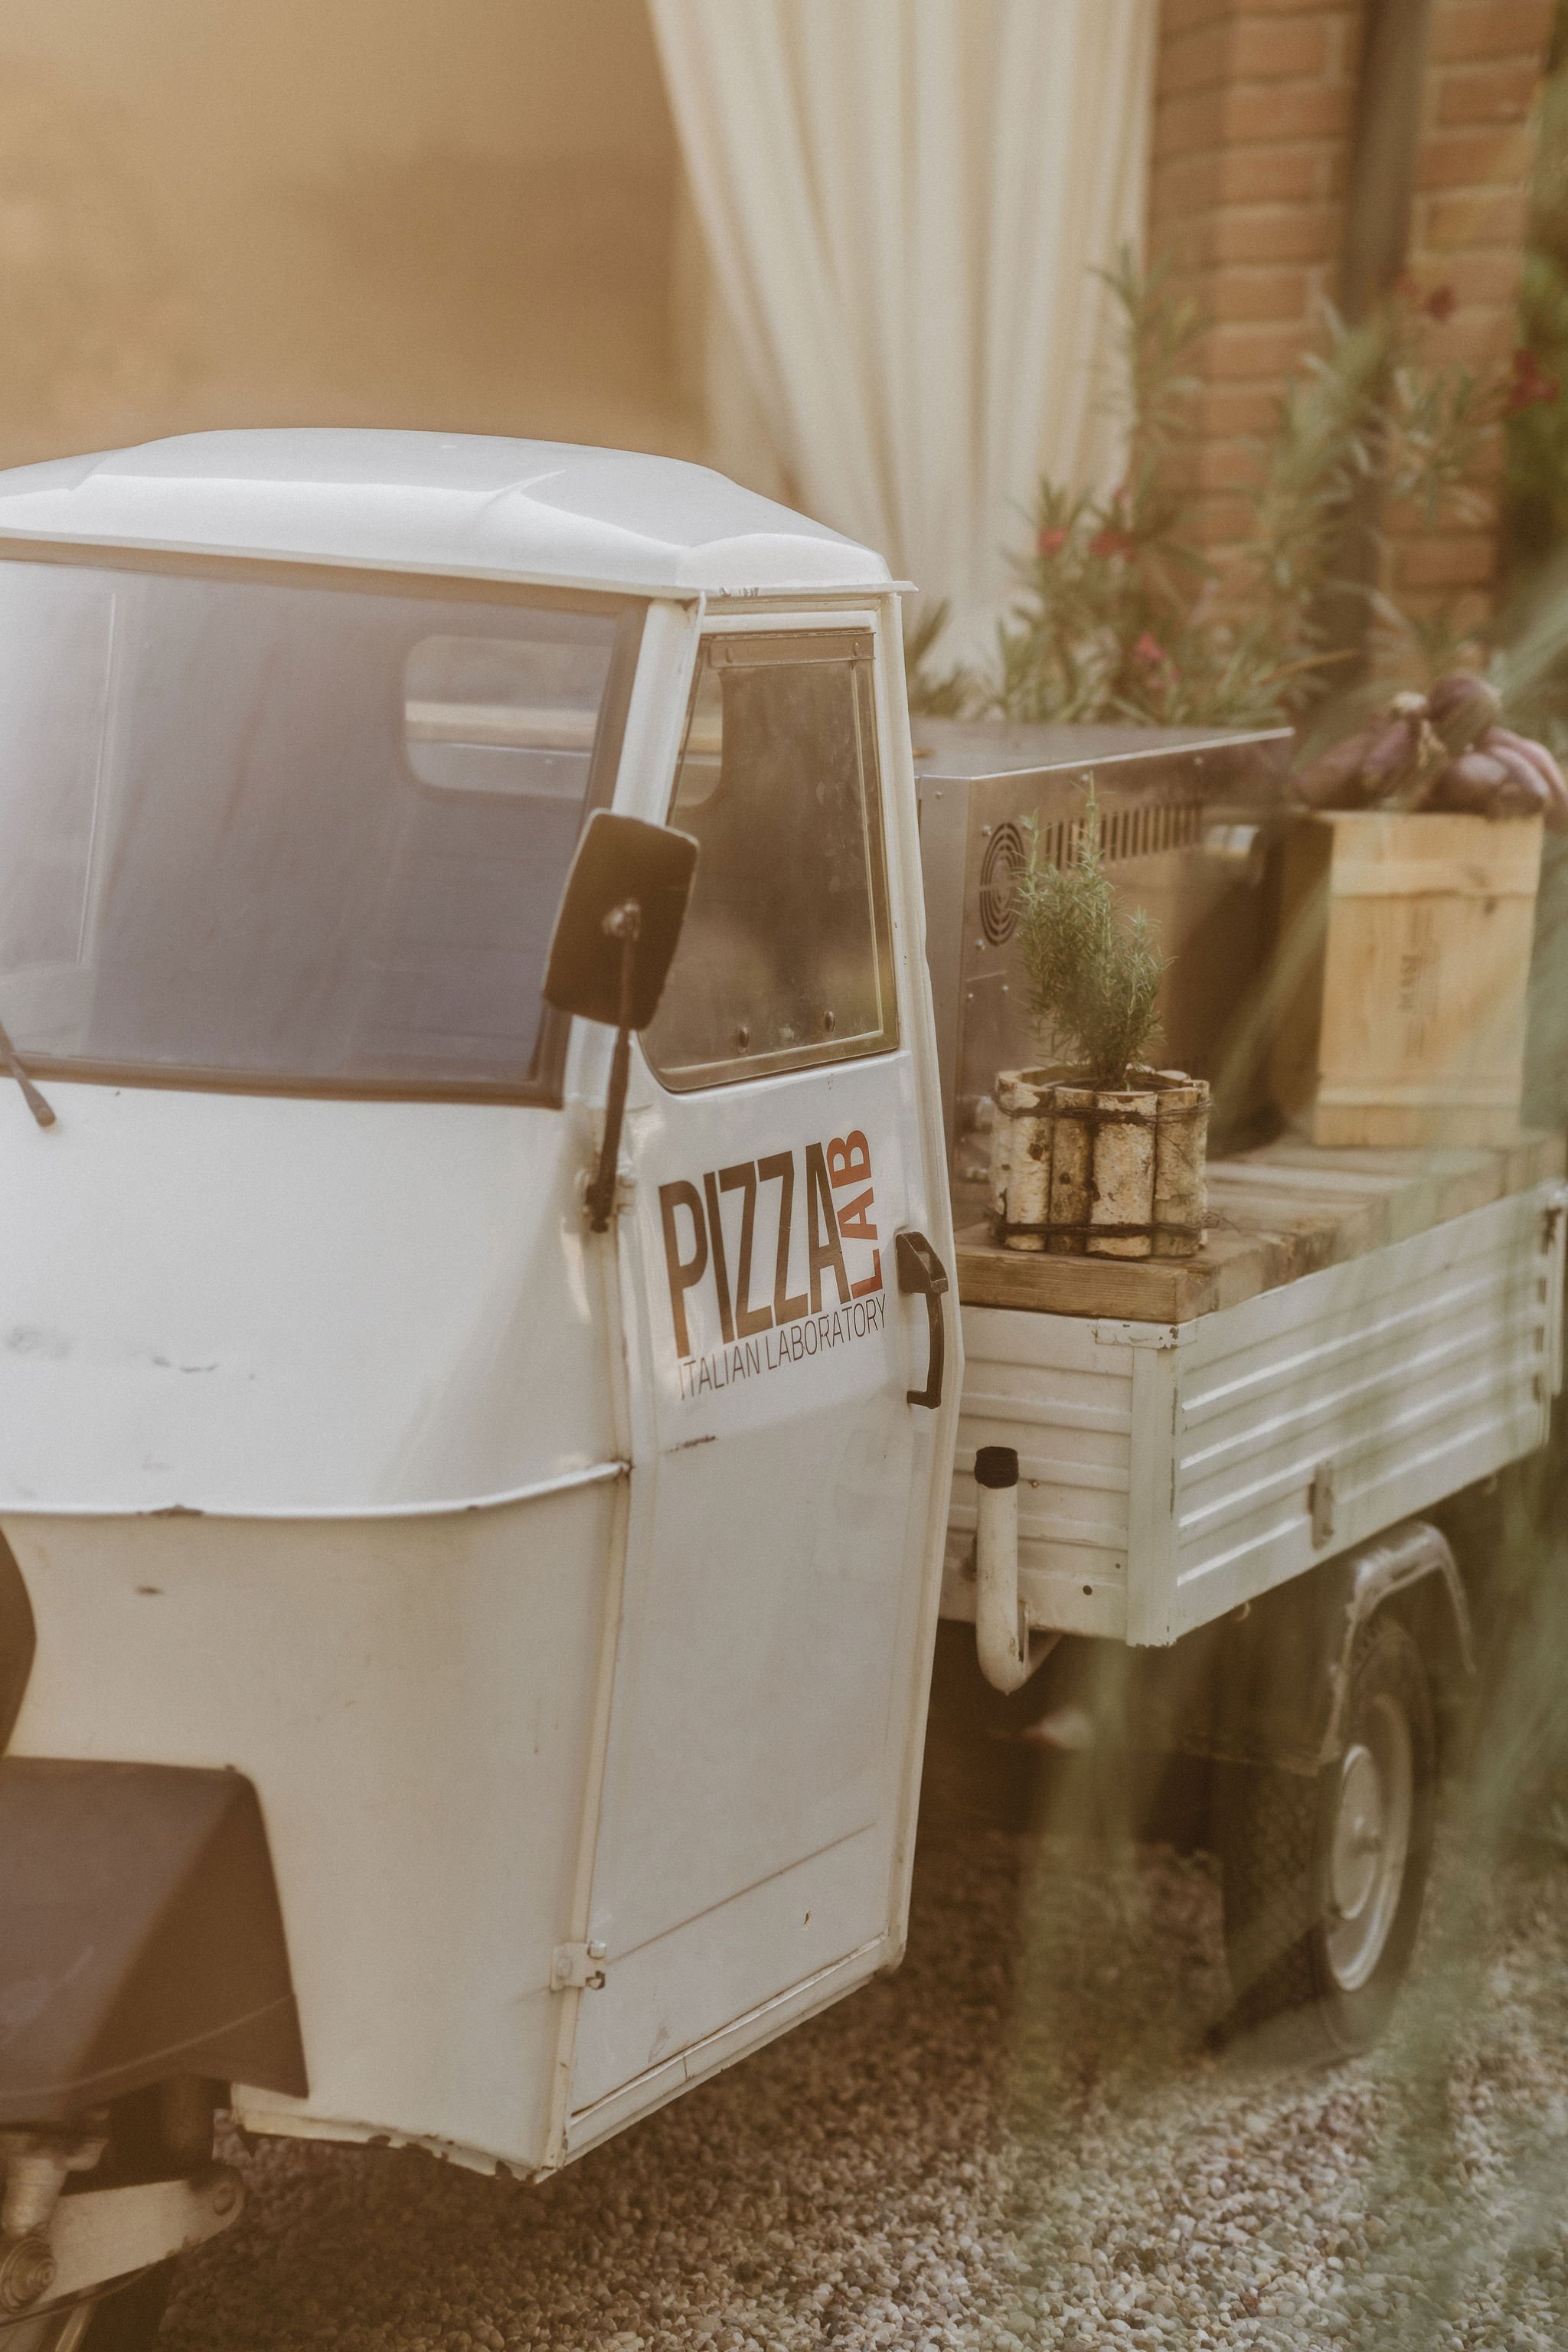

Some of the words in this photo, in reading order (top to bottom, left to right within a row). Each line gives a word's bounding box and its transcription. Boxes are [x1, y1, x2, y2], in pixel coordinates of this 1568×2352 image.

[658, 1142, 851, 1359] PIZZA
[826, 1129, 884, 1299] LAB
[678, 1338, 760, 1400] ITALIAN
[766, 1294, 886, 1370] LABORATORY
